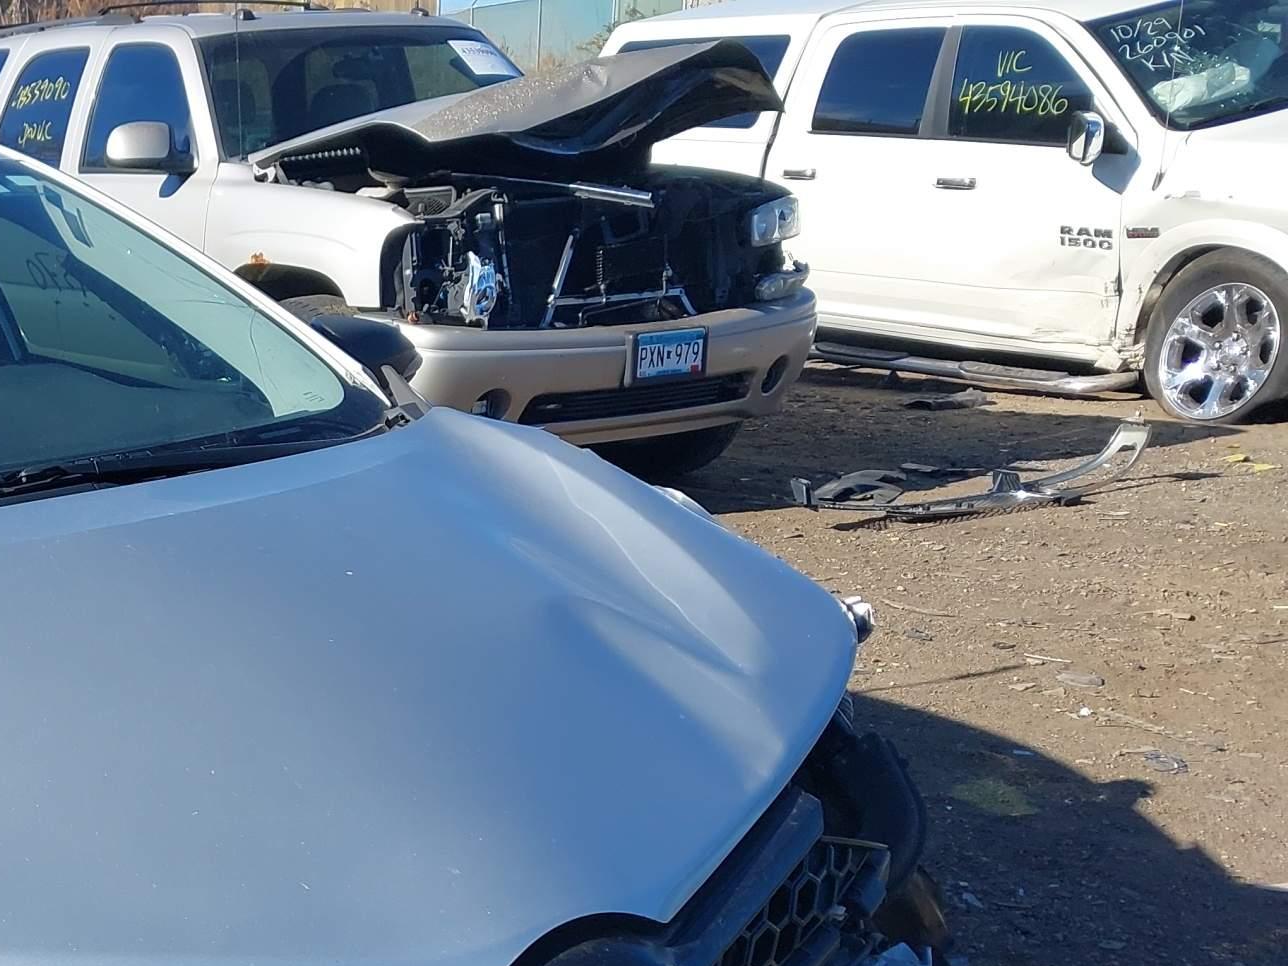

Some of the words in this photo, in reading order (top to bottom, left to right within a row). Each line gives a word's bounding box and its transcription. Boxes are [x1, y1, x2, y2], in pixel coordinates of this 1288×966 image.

[1110, 17, 1172, 43] 10/29
[1118, 24, 1206, 60] 260901
[997, 50, 1033, 77] VIC
[959, 78, 1069, 116] 43594086
[1059, 225, 1114, 239] RAM
[1059, 236, 1114, 251] 1500
[639, 344, 665, 370] PXN
[675, 341, 700, 365] 979
